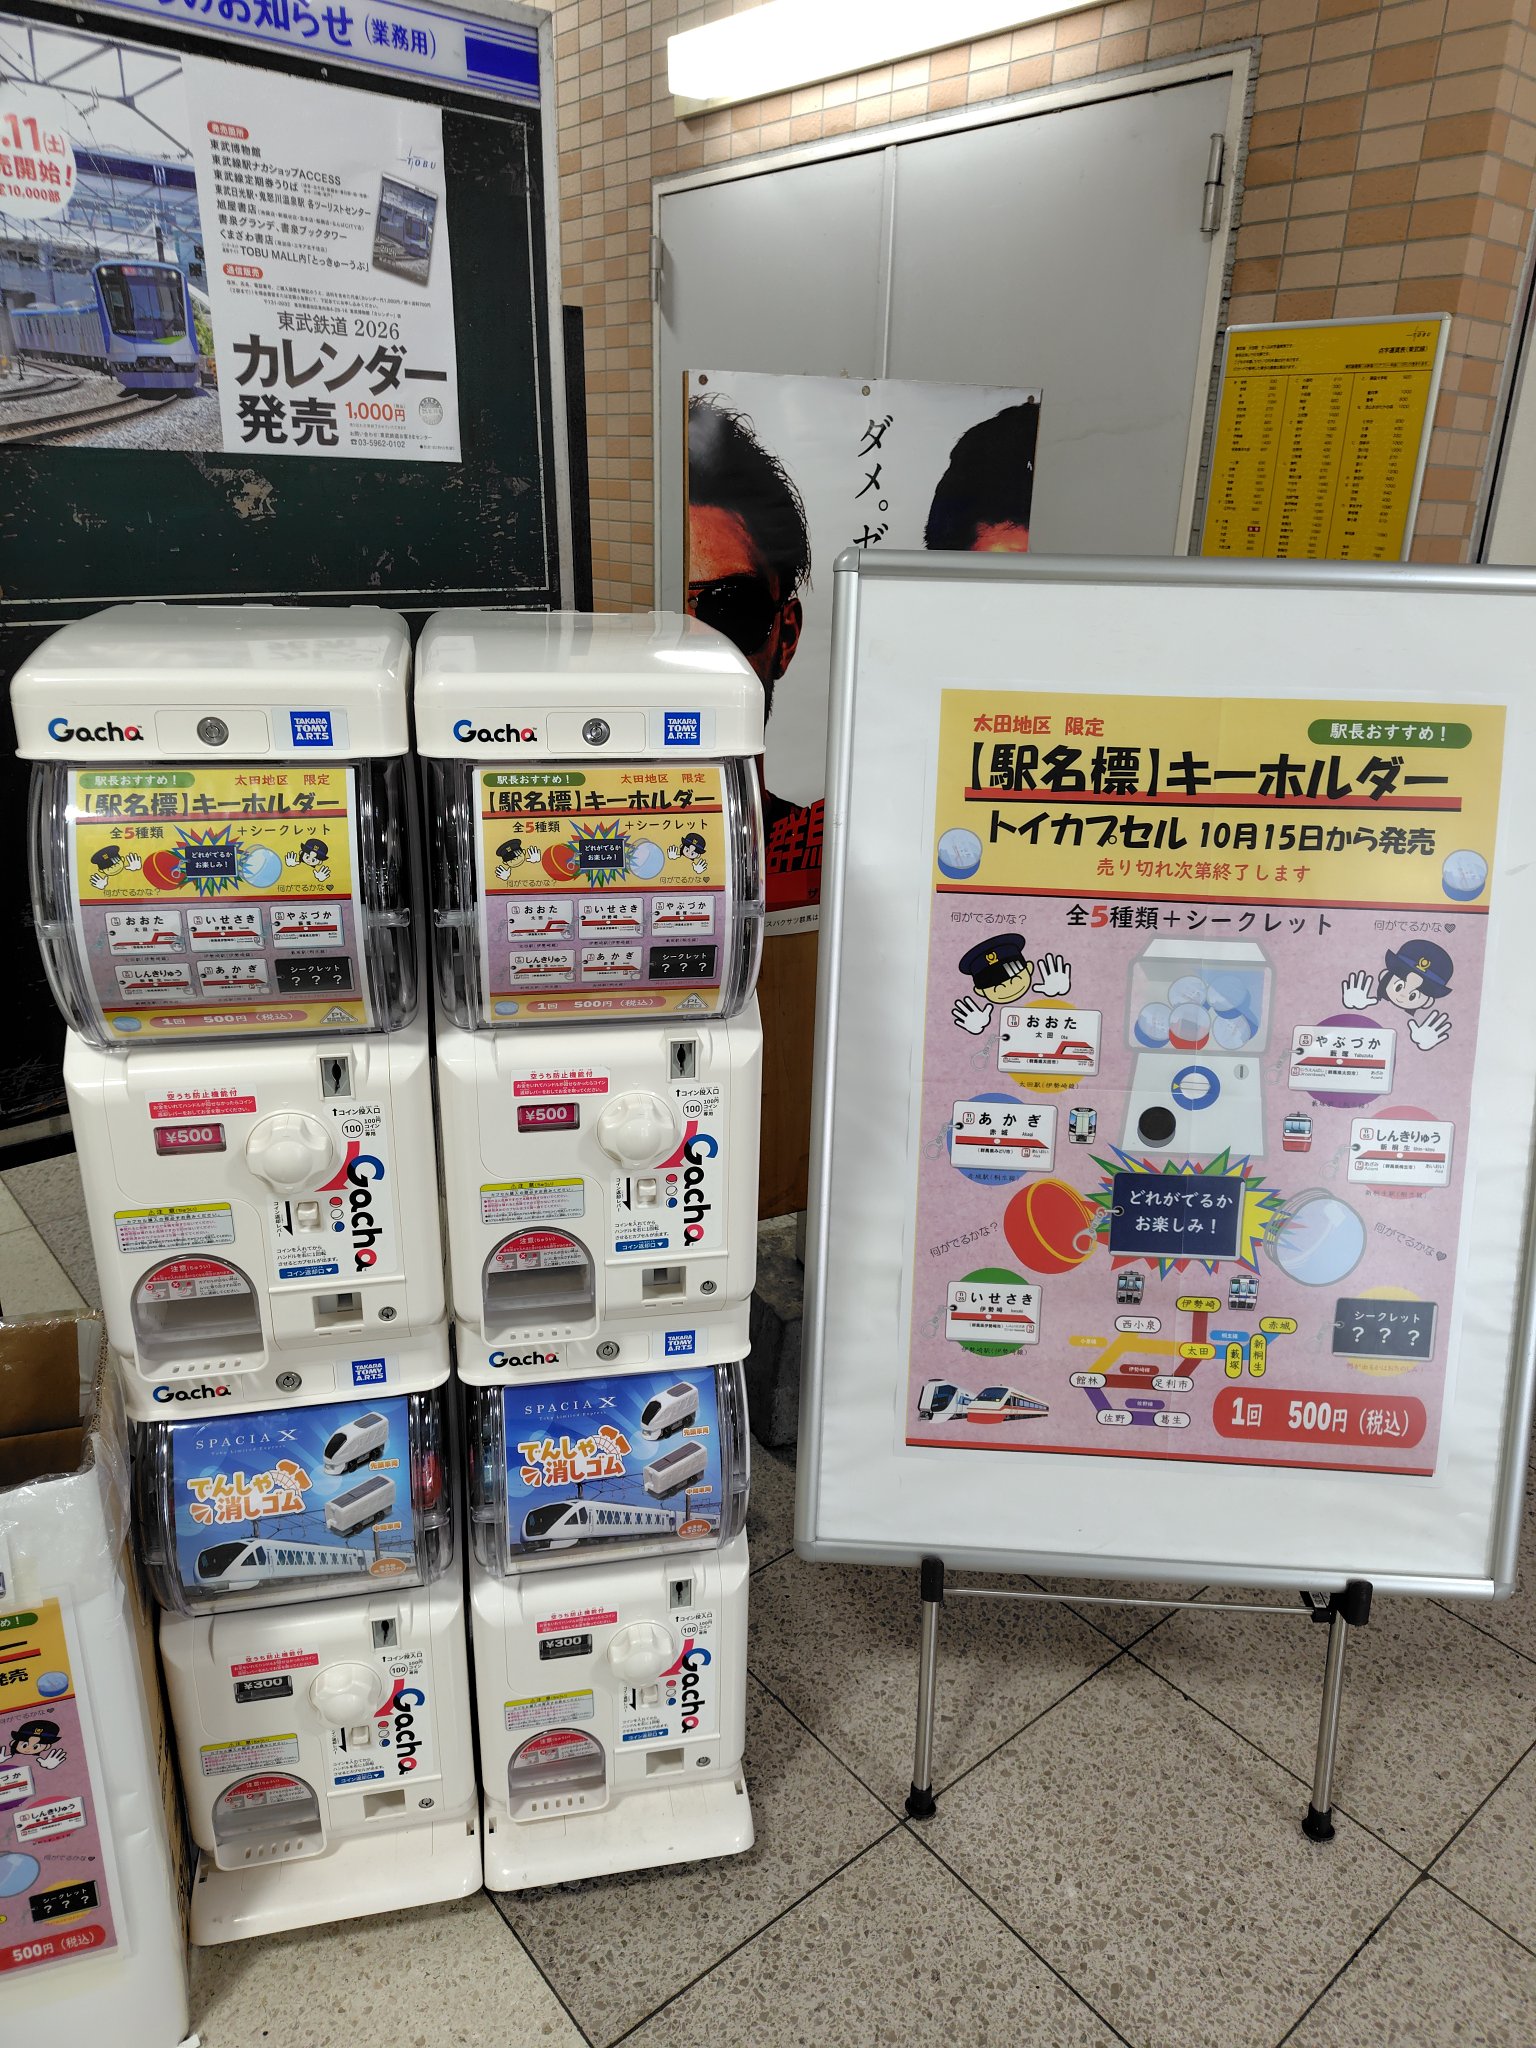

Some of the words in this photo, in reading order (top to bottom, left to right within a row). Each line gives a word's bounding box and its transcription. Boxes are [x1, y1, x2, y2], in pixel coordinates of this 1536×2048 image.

[210, 139, 261, 158] 東武博物館
[212, 154, 341, 186] 東武線駅ナカショップACCESS
[213, 169, 298, 192] 東武線定期券うりば
[215, 184, 305, 209] 東武日光駅・鬼怒川温泉駅
[308, 198, 371, 218] 各ツーリストセンター
[217, 199, 257, 215] 旭屋書店
[218, 214, 348, 240] 書泉グランデ、書泉ブックタワー
[220, 229, 274, 247] くまざわ書店
[241, 246, 269, 258] TOBU
[277, 311, 348, 337] 東武鉄道
[354, 319, 400, 340] 2026
[232, 333, 448, 396] カレンダー
[236, 394, 340, 446] 発売
[345, 401, 406, 423] 1,000円
[358, 439, 406, 449] 03-5962-0102
[48, 717, 143, 742] Gacha
[294, 725, 327, 733] TOMY
[453, 719, 537, 743] Gacha
[973, 713, 1051, 736] 太田地区
[1065, 716, 1105, 737] 限定
[1329, 722, 1447, 744] 駅長おすすめ！
[970, 741, 1449, 802] 【駅名標】キーホルダー
[95, 774, 178, 786] 駅長おすすめ！
[235, 774, 288, 785] 太田地区
[303, 773, 331, 785] 限定
[497, 774, 571, 785] 駅長おすすめ！
[621, 773, 668, 784] 太田地区
[682, 772, 706, 784] 限定
[489, 788, 715, 813] 【駅名標】キーホルダー
[110, 826, 164, 839] 全5種類
[512, 820, 560, 833] 全5種類
[988, 810, 1187, 850] トイカプセル
[1200, 821, 1436, 856] 10月15日から発売
[191, 851, 233, 859] どれがでるか
[1096, 858, 1311, 883] 売り切れ次第終了します
[524, 905, 558, 914] おおた
[594, 904, 638, 913] いせさき
[666, 901, 707, 910] やぶづか
[126, 915, 164, 926] おおた
[205, 914, 255, 925] いせさき
[286, 910, 332, 921] やぶづか
[525, 955, 568, 964] しんきりゅう
[596, 951, 634, 961] あかぎ
[662, 952, 707, 961] シークレット
[134, 969, 182, 979] しんきりゅう
[215, 963, 257, 975] あかぎ
[290, 964, 340, 974] シークレット
[537, 1001, 558, 1010] 1回
[574, 998, 612, 1009] 500円
[161, 1017, 186, 1026] 1回
[203, 1014, 247, 1024] 500円
[1027, 1015, 1077, 1030] おおた
[1316, 1035, 1381, 1050] やぶづか
[530, 1071, 593, 1079] 空うち防止機能付
[167, 1089, 237, 1100] 空うち防止機能付
[681, 1088, 719, 1097] コイン投入口
[338, 1107, 381, 1116] コイン投入口
[525, 1106, 567, 1121] ¥500
[685, 1105, 701, 1113] 100
[979, 1112, 1041, 1128] あかぎ
[166, 1128, 212, 1143] ¥500
[344, 1125, 361, 1133] 100
[1376, 1129, 1441, 1144] しんきりゅう
[1380, 1144, 1411, 1152] 新桐生
[684, 1133, 719, 1246] Gacha
[1130, 1189, 1233, 1209] どれがでるか
[347, 1155, 385, 1272] Gacha
[1135, 1216, 1217, 1234] お楽しみ！
[622, 1242, 656, 1250] コイン返却口
[287, 1268, 325, 1277] コイン返却口
[971, 1293, 1033, 1306] いせさき
[1181, 1298, 1216, 1310] 伊勢崎
[1354, 1311, 1420, 1324] シークレット
[1122, 1319, 1156, 1331] 西小泉
[1268, 1320, 1291, 1331] 赤城
[1187, 1346, 1209, 1356] 太田
[1253, 1339, 1264, 1372] 新桐生
[489, 1351, 559, 1368] Gacha
[355, 1362, 383, 1371] TAKARA
[356, 1368, 383, 1376] TOMY
[1076, 1374, 1098, 1385] 館林
[1154, 1378, 1189, 1390] 足利市
[152, 1384, 231, 1403] Gacha
[524, 1399, 592, 1415] SPACIA
[599, 1397, 617, 1409] X
[1104, 1413, 1125, 1423] 佐野
[1161, 1415, 1182, 1425] 葛生
[1231, 1397, 1262, 1428] 1回
[1288, 1400, 1347, 1433] 500円
[195, 1433, 271, 1450] SPACIA
[278, 1428, 298, 1443] X
[518, 1437, 596, 1465] でんしゃ
[546, 1457, 625, 1486] 消しゴム
[188, 1472, 273, 1500] でんしゃ
[215, 1495, 305, 1523] 消しゴム
[680, 1612, 712, 1621] コイン投入口
[546, 1637, 581, 1648] ¥300
[388, 1652, 423, 1661] コイン投入口
[244, 1678, 283, 1690] ¥300
[682, 1648, 711, 1733] Gacha
[393, 1688, 425, 1775] Gacha
[31, 1803, 76, 1821] しんきりゅう
[42, 1888, 87, 1904] シークレット
[12, 1942, 55, 1962] 500円
